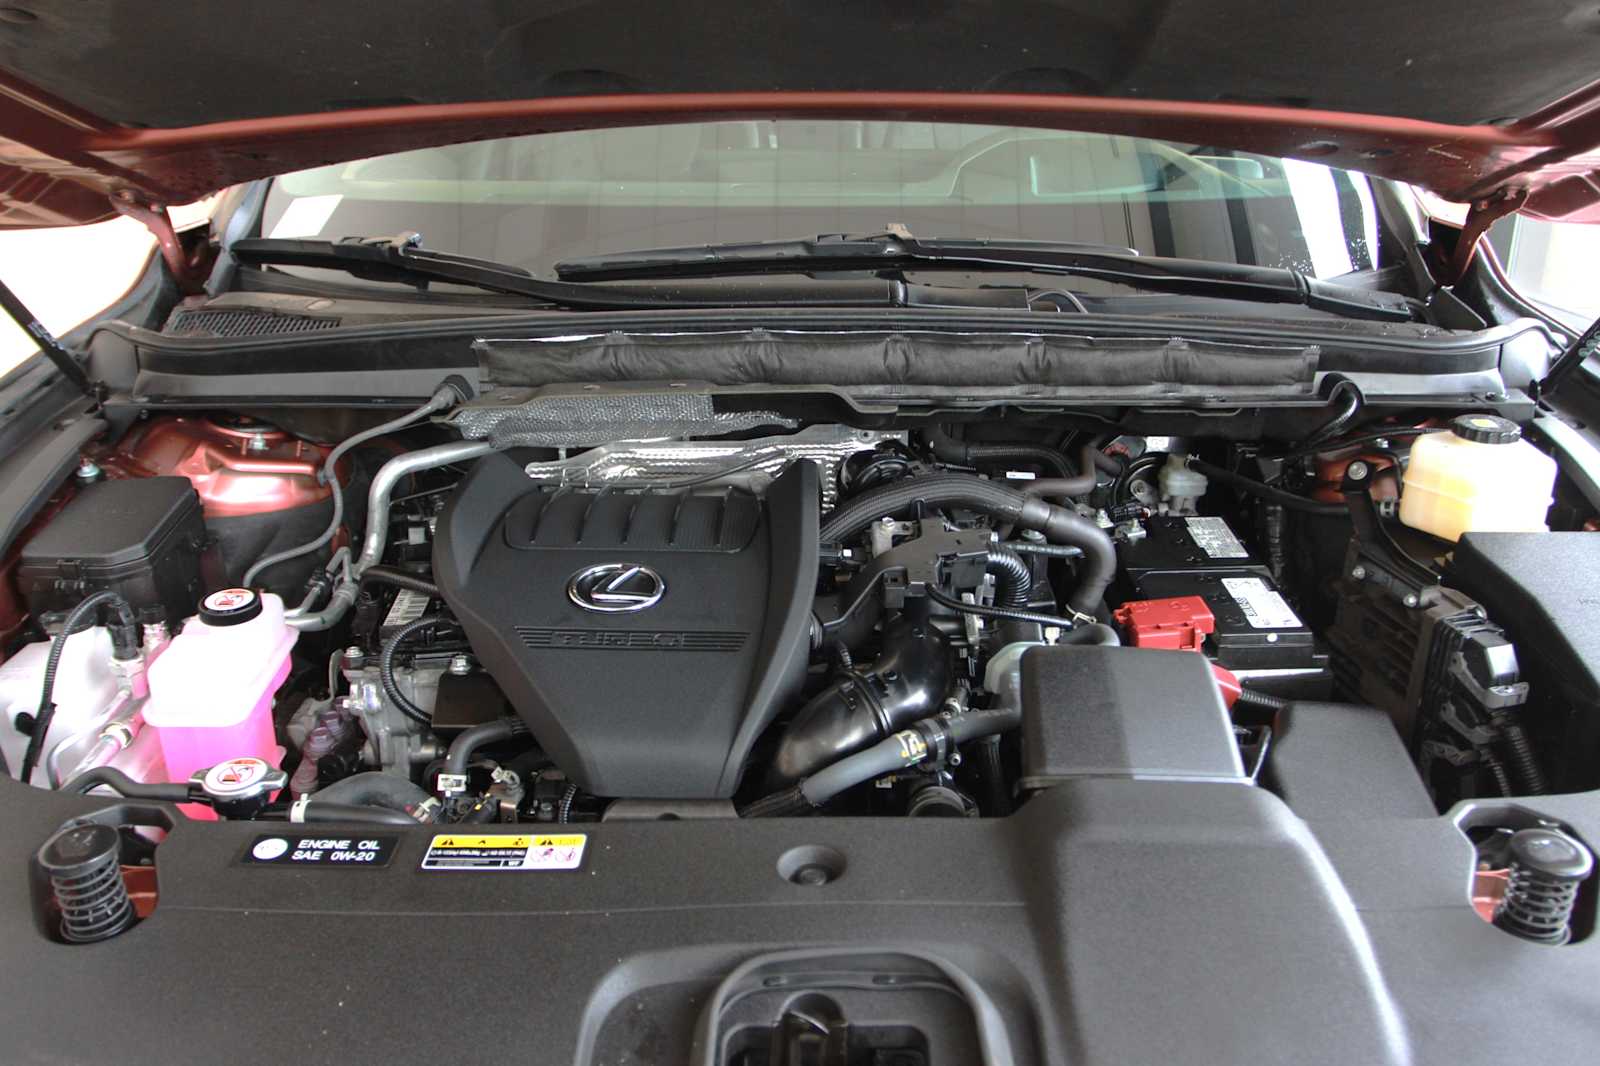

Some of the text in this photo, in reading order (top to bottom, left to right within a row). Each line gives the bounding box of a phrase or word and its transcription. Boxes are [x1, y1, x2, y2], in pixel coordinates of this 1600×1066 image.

[297, 839, 380, 850] ENGINE OIL
[292, 850, 376, 861] SAE 0W-20
